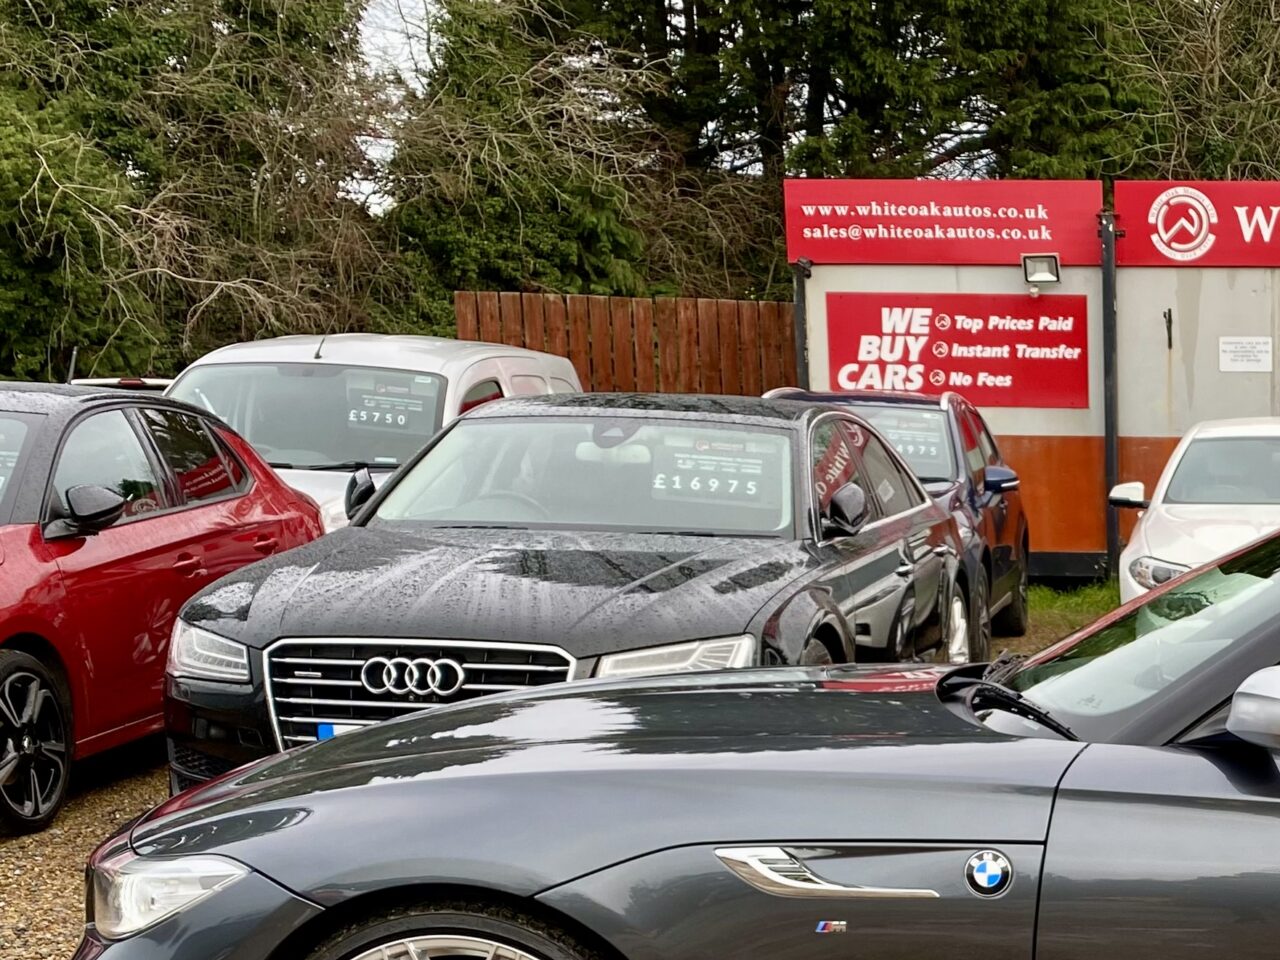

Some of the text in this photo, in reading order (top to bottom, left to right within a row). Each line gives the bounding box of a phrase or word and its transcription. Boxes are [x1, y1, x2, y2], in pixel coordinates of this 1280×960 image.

[801, 201, 1049, 220] www.whiteoakautos.co.uk
[803, 223, 1052, 241] sales@whiteoakautos.co.uk
[881, 307, 933, 335] WE
[954, 315, 1074, 334] Top Prices Paid
[857, 335, 929, 363] BUY
[951, 342, 1081, 360] Instant Transfer
[837, 363, 925, 391] CARS
[948, 371, 1012, 387] No Fees
[348, 409, 406, 425] £5750
[653, 473, 757, 495] £16975
